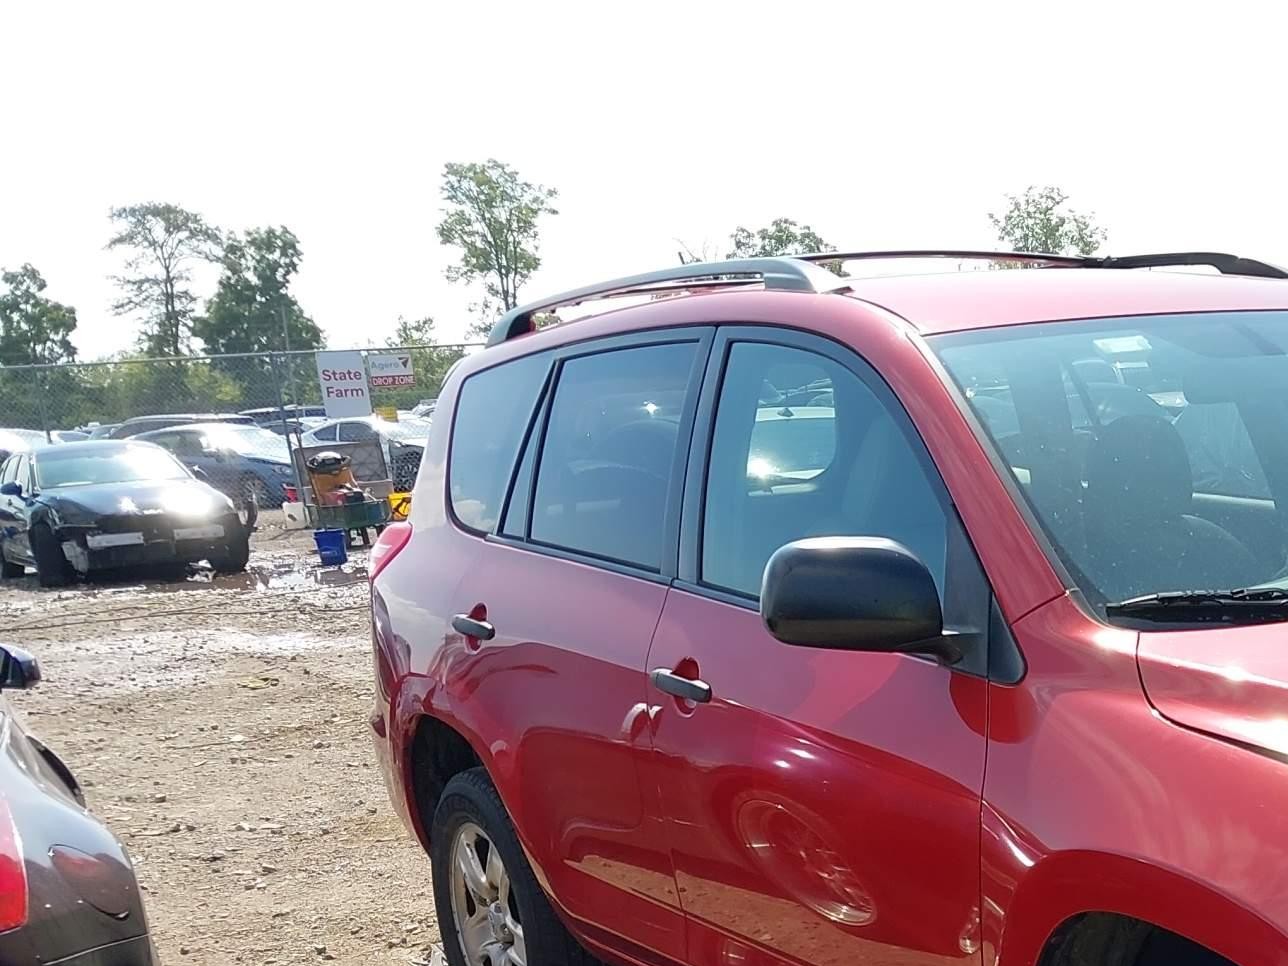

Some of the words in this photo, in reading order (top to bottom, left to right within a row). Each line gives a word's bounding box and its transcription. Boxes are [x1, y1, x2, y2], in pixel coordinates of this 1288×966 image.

[322, 369, 362, 381] State
[372, 377, 393, 386] DROP
[395, 376, 416, 385] ZONE
[326, 386, 365, 398] Farm
